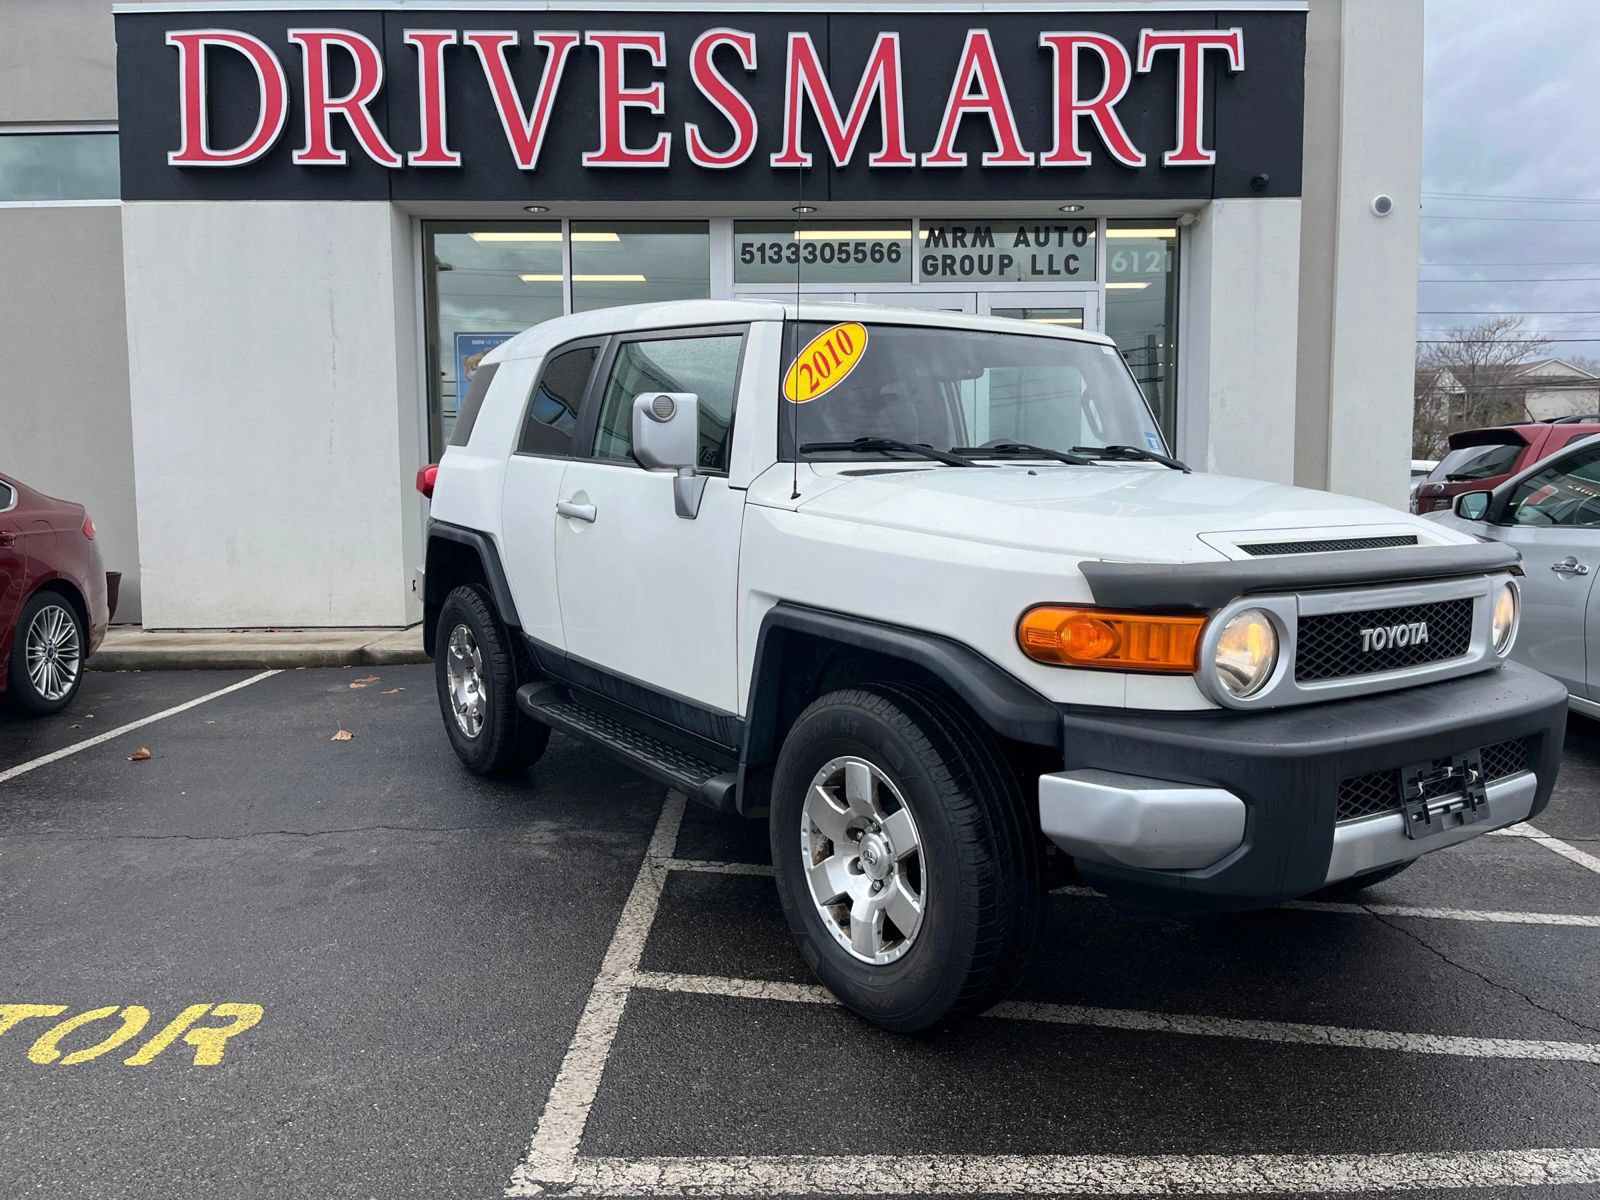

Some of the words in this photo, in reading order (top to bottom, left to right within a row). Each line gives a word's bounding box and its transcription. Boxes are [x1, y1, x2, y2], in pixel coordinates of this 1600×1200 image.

[165, 27, 1246, 171] DRIVESMART
[924, 226, 995, 249] MRM
[1012, 226, 1088, 248] AUTO
[740, 242, 902, 265] 5133305566
[921, 254, 1014, 276] GROUP
[1031, 254, 1080, 276] LLC
[800, 329, 854, 394] 2010
[1360, 621, 1429, 652] TOYOTA
